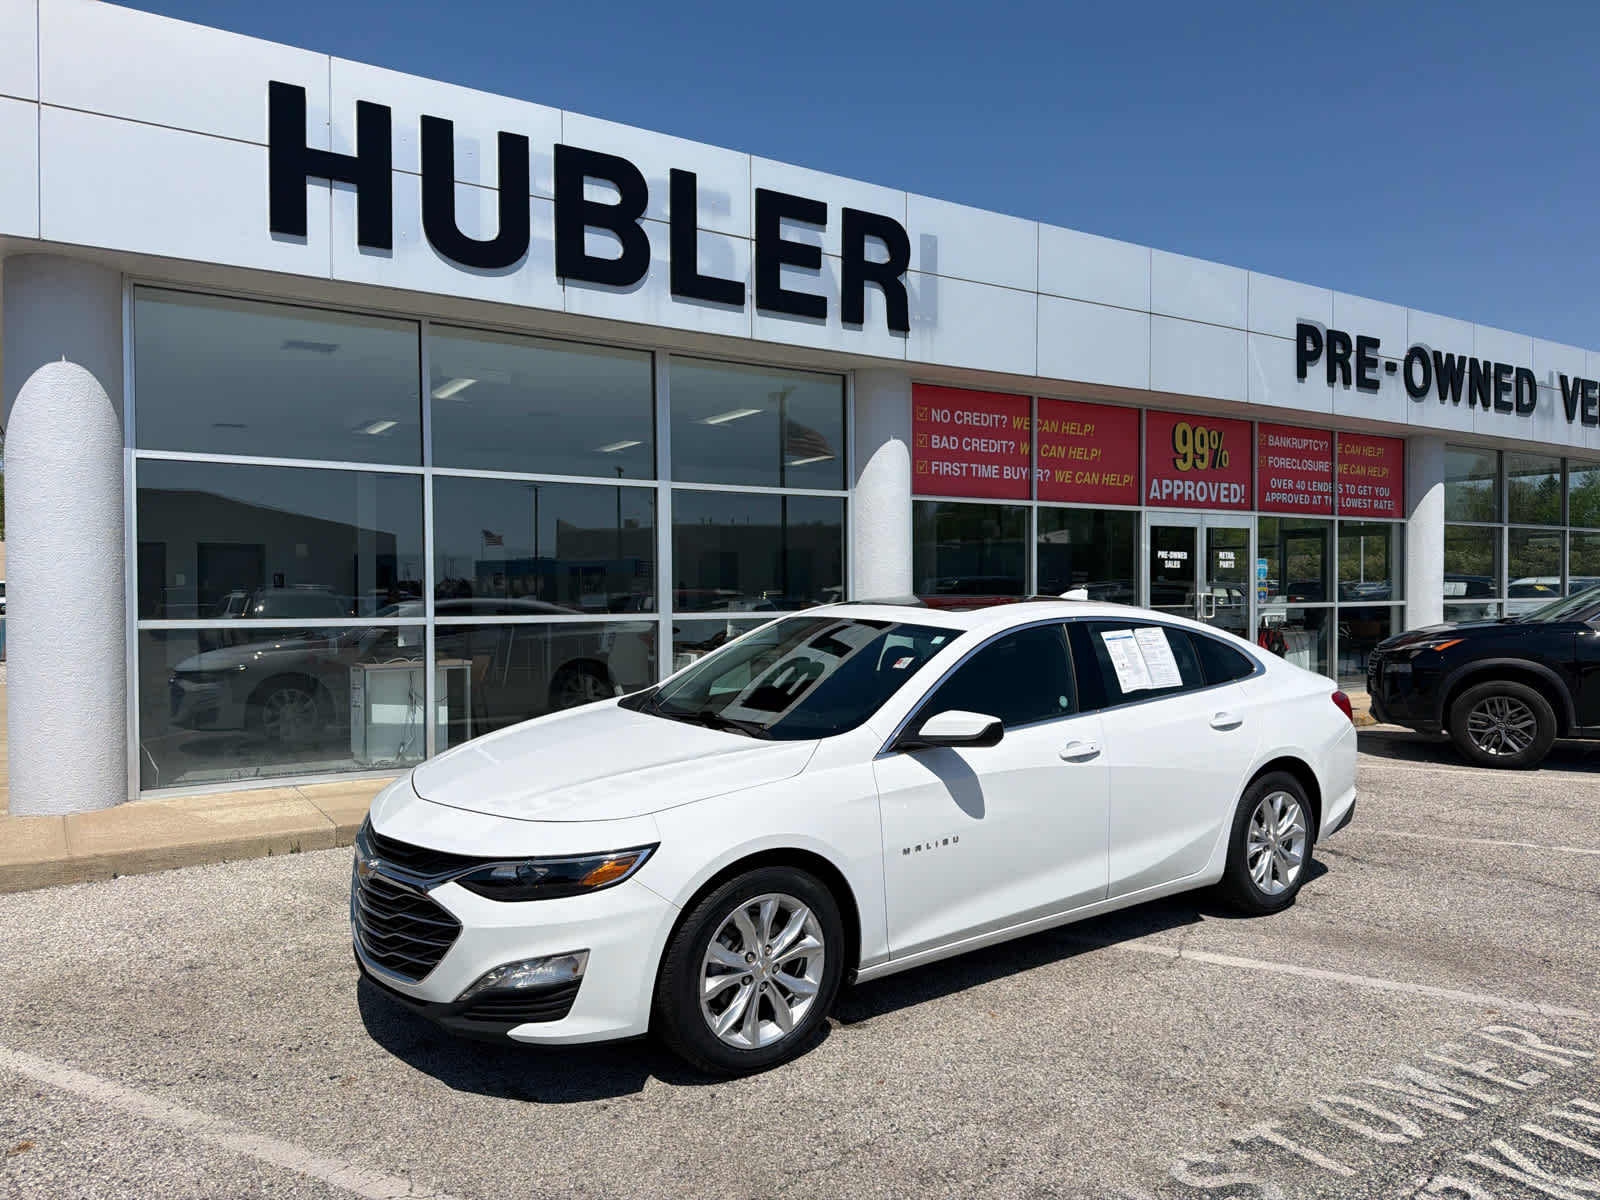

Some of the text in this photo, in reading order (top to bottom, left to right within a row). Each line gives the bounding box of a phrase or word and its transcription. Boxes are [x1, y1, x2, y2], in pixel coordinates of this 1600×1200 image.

[269, 80, 911, 332] HUBLER
[1296, 322, 1538, 416] PRE-OWNED
[1560, 374, 1600, 428] VE
[931, 408, 951, 423] NO
[954, 410, 1008, 429] CREDIT?
[1012, 415, 1031, 431] WE
[1061, 420, 1095, 437] HELP!
[931, 434, 1102, 462] BAD CREDIT? W CAN HELP!
[1172, 421, 1229, 472] 99%
[1268, 434, 1329, 451] BANKRUPTCY?
[1345, 443, 1361, 456] CAN
[1362, 446, 1385, 459] HELP!
[931, 461, 1134, 488] FIRST TIME BUYR? WE CAN HELP!
[1350, 464, 1366, 476] CAN
[1367, 466, 1390, 479] HELP!
[1149, 478, 1246, 504] APPROVED!
[1270, 477, 1391, 498] OVER 40 LENDES TO GET YOU
[1265, 492, 1310, 505] APPROVED
[1311, 494, 1322, 506] AT
[1341, 496, 1372, 510] LOWEST
[1373, 499, 1395, 511] RATE!
[1157, 550, 1188, 560] PRE-OWNED
[1164, 560, 1181, 569] SALES
[1218, 551, 1236, 560] RETAIL
[902, 835, 959, 856] MALIBU
[1168, 1025, 1594, 1200] STOMER
